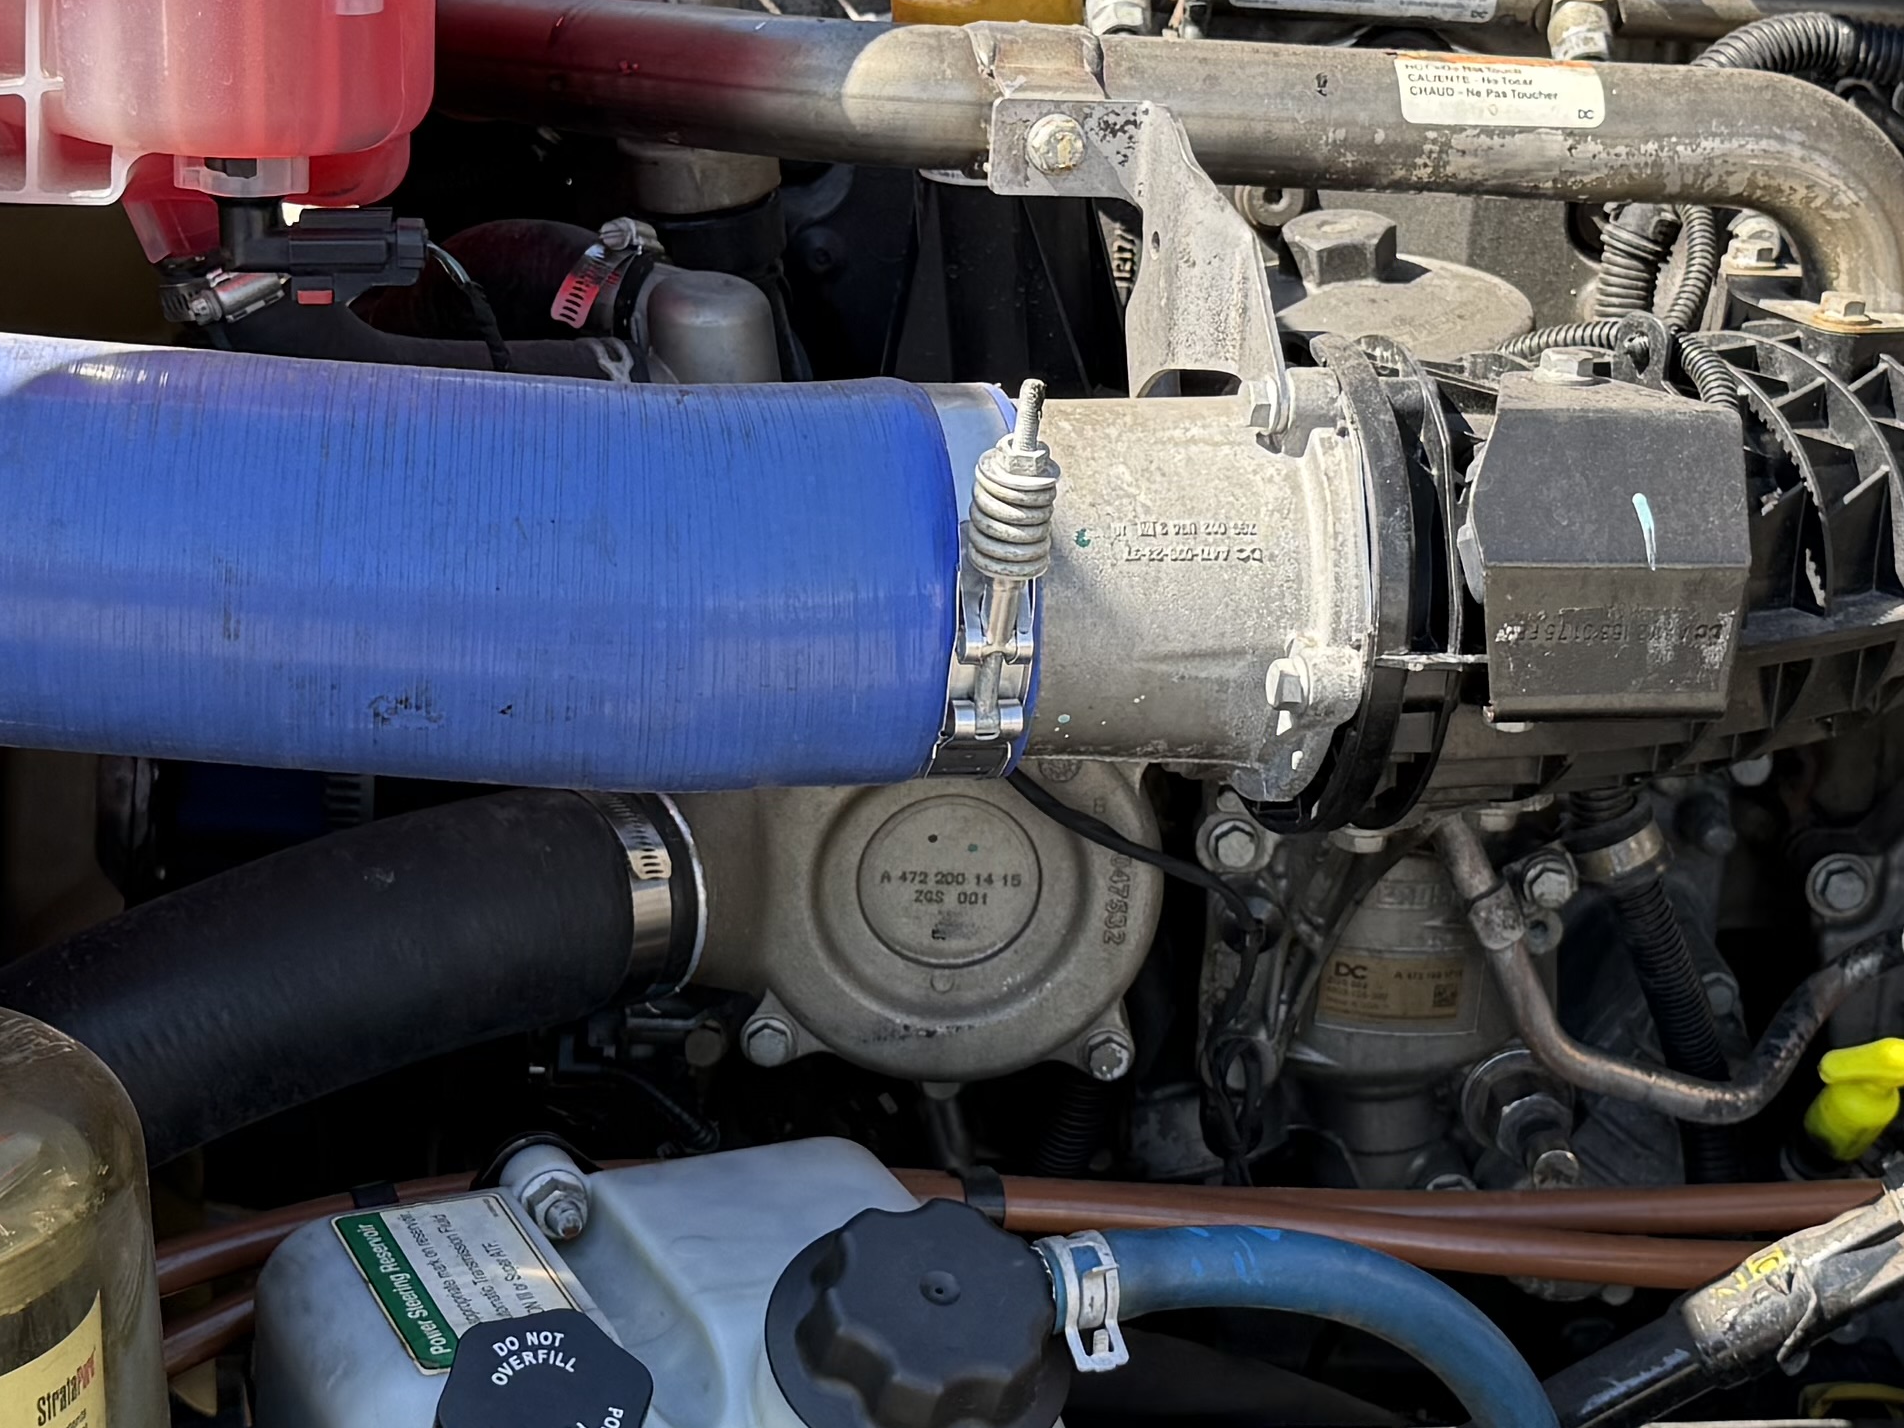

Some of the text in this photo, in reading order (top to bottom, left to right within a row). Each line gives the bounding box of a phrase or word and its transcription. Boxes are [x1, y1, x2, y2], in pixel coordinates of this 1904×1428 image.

[1410, 86, 1558, 100] CHAUD Ne Pas Toucher
[880, 870, 892, 884] A
[898, 871, 928, 885] 472
[934, 871, 966, 885] 200
[974, 872, 994, 887] 14
[913, 889, 988, 906] ZGS 001
[1334, 961, 1368, 980] DC
[431, 1214, 489, 1286] Transmission Fluid
[357, 1223, 452, 1356] Power Steering Reservoir
[492, 1331, 564, 1357] DO NOT
[491, 1349, 577, 1386] OVERFILL
